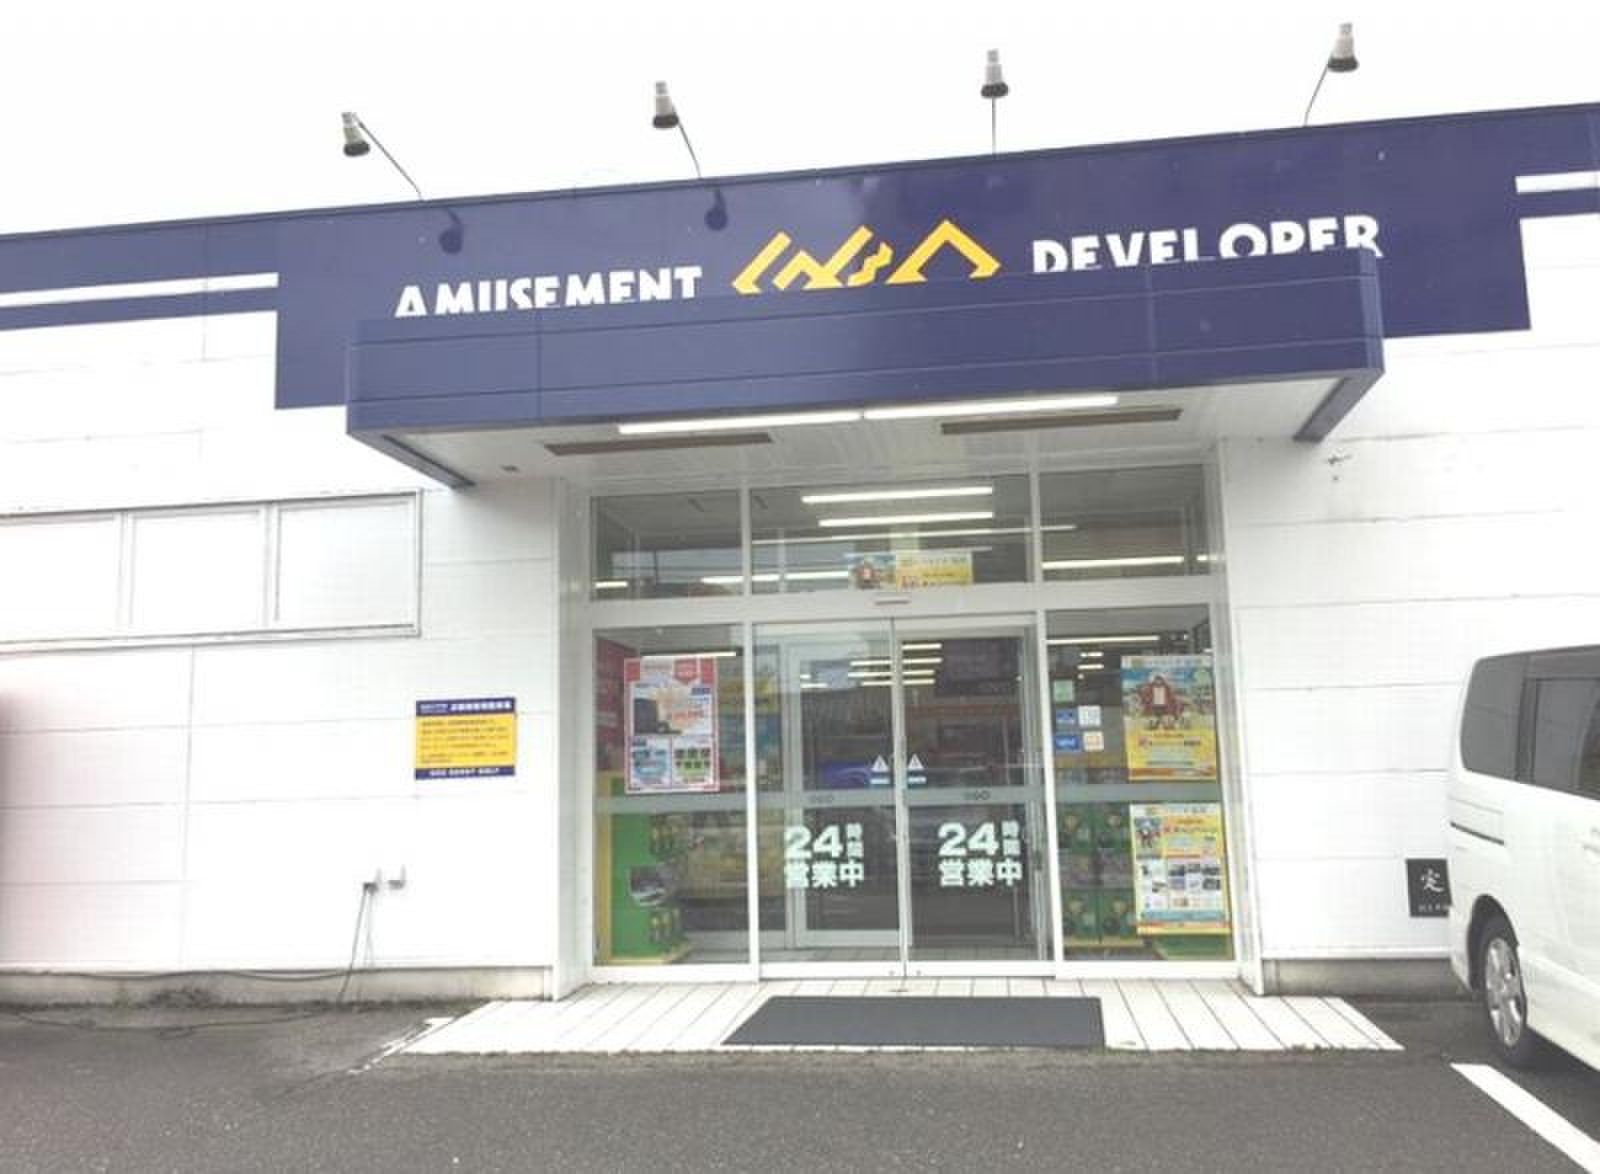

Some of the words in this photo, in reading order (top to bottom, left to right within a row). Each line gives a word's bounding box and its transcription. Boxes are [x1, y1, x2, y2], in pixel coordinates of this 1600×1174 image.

[394, 265, 703, 318] AMUSEMENT
[1032, 214, 1383, 274] DEVELOPER
[783, 860, 865, 889] 営業中
[938, 858, 1023, 887] 営業中
